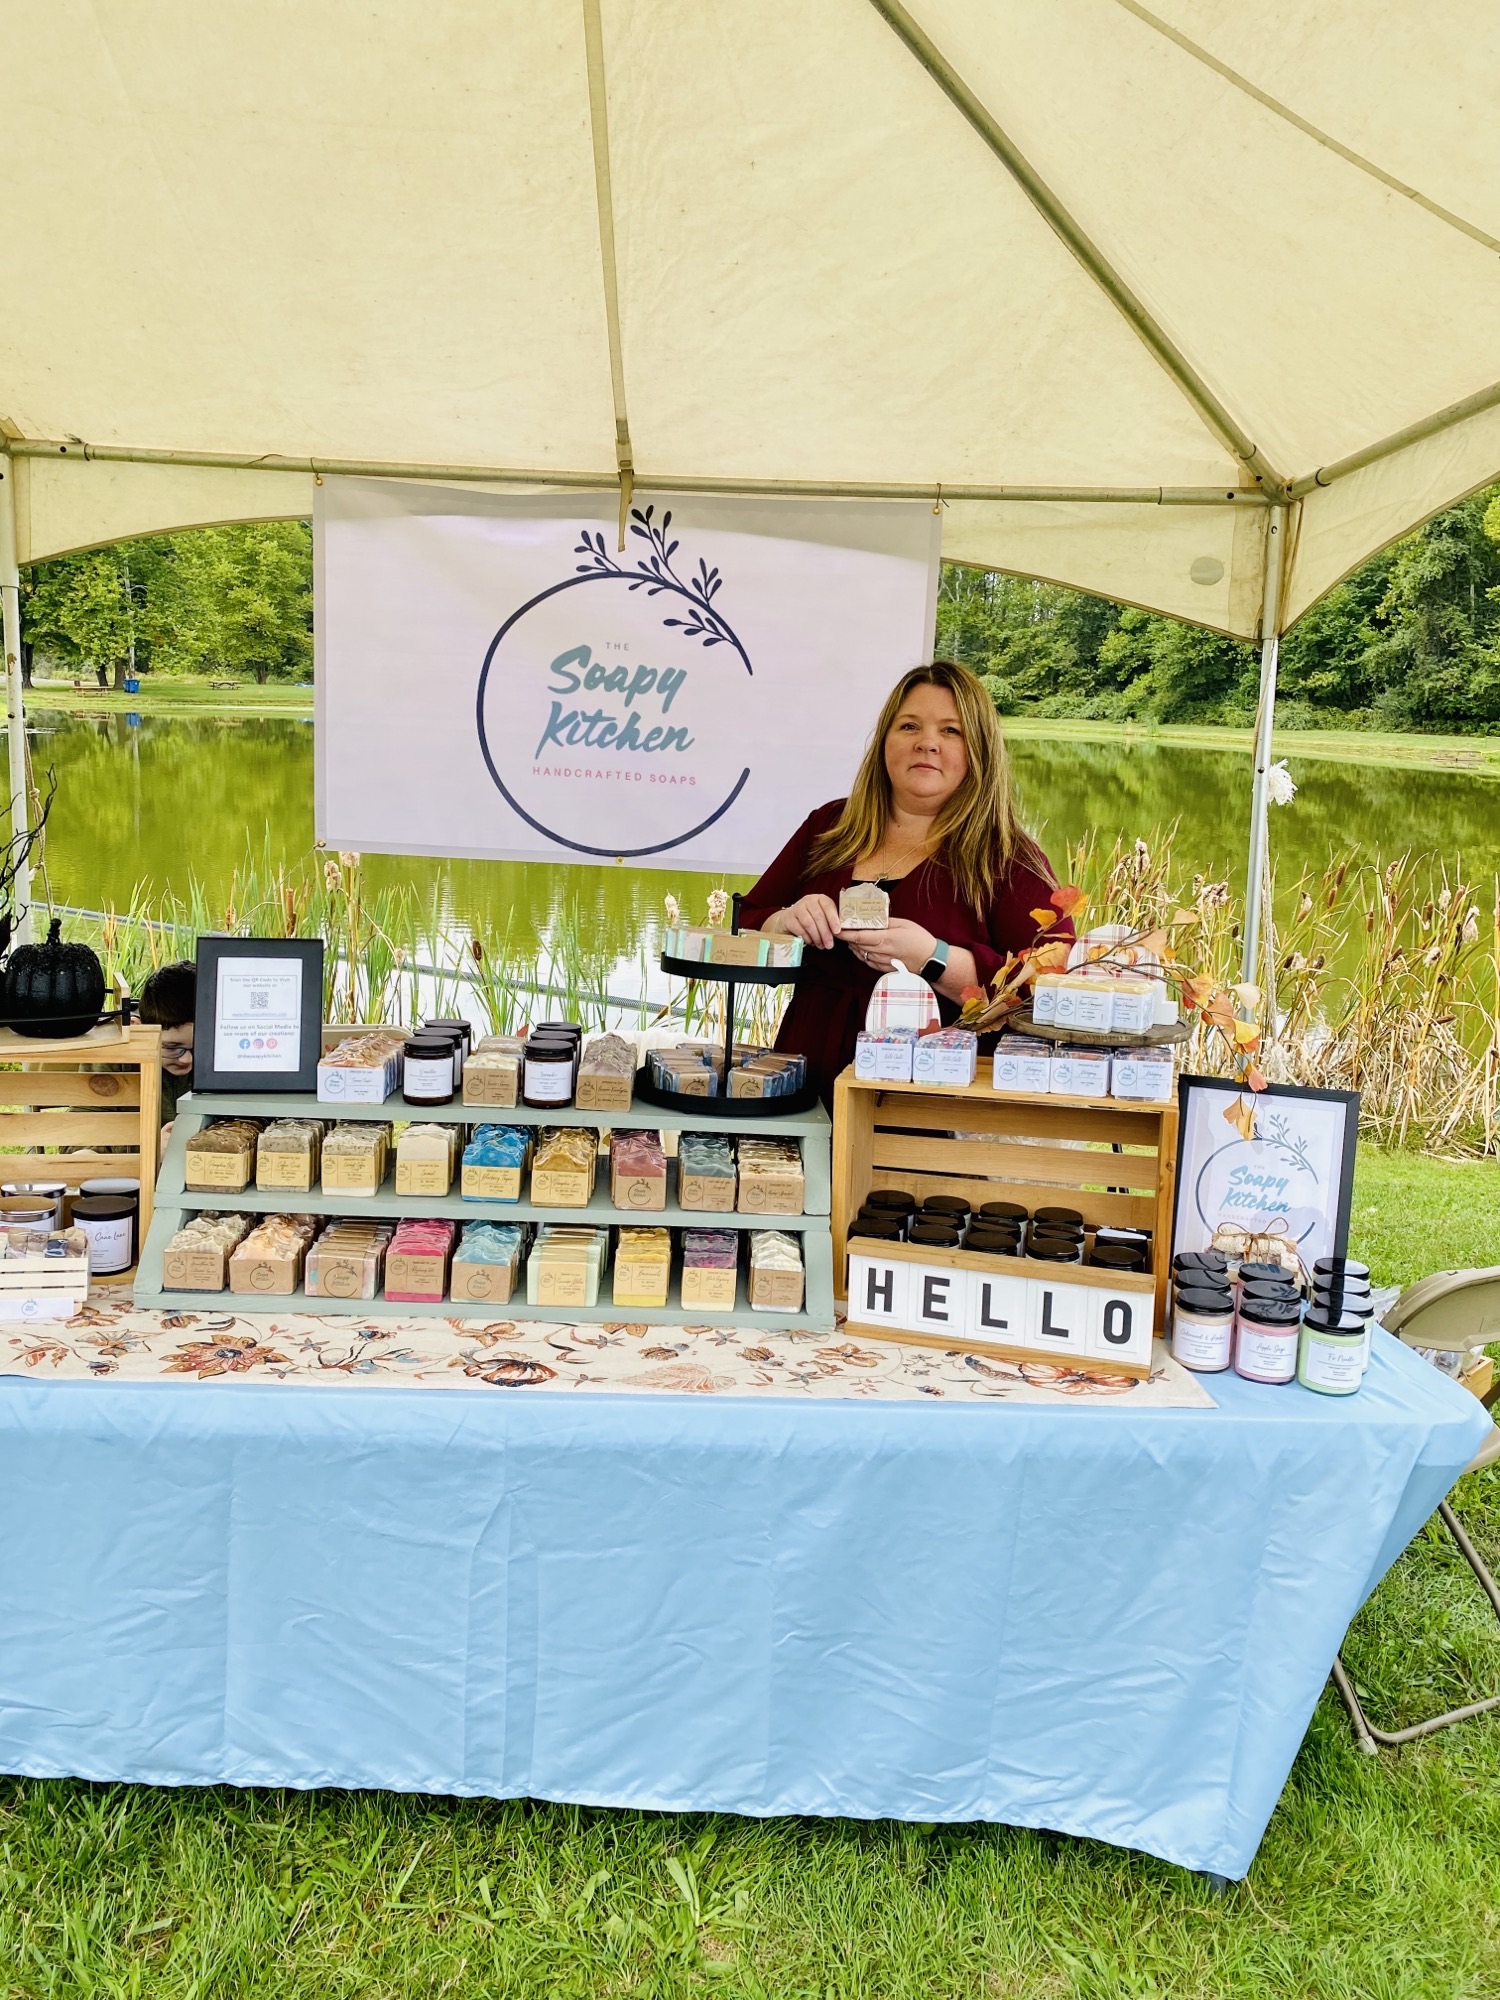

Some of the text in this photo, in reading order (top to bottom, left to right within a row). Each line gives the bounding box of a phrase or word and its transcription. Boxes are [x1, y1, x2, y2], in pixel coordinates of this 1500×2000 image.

[605, 642, 630, 651] THE
[547, 644, 688, 714] Soapy
[534, 700, 695, 760] Kitchen
[532, 766, 697, 786] HANDCRAFTED SOAPS
[1228, 1165, 1290, 1196] Soapy
[1219, 1187, 1292, 1213] Kitchen
[866, 1267, 1133, 1345] HELLO
